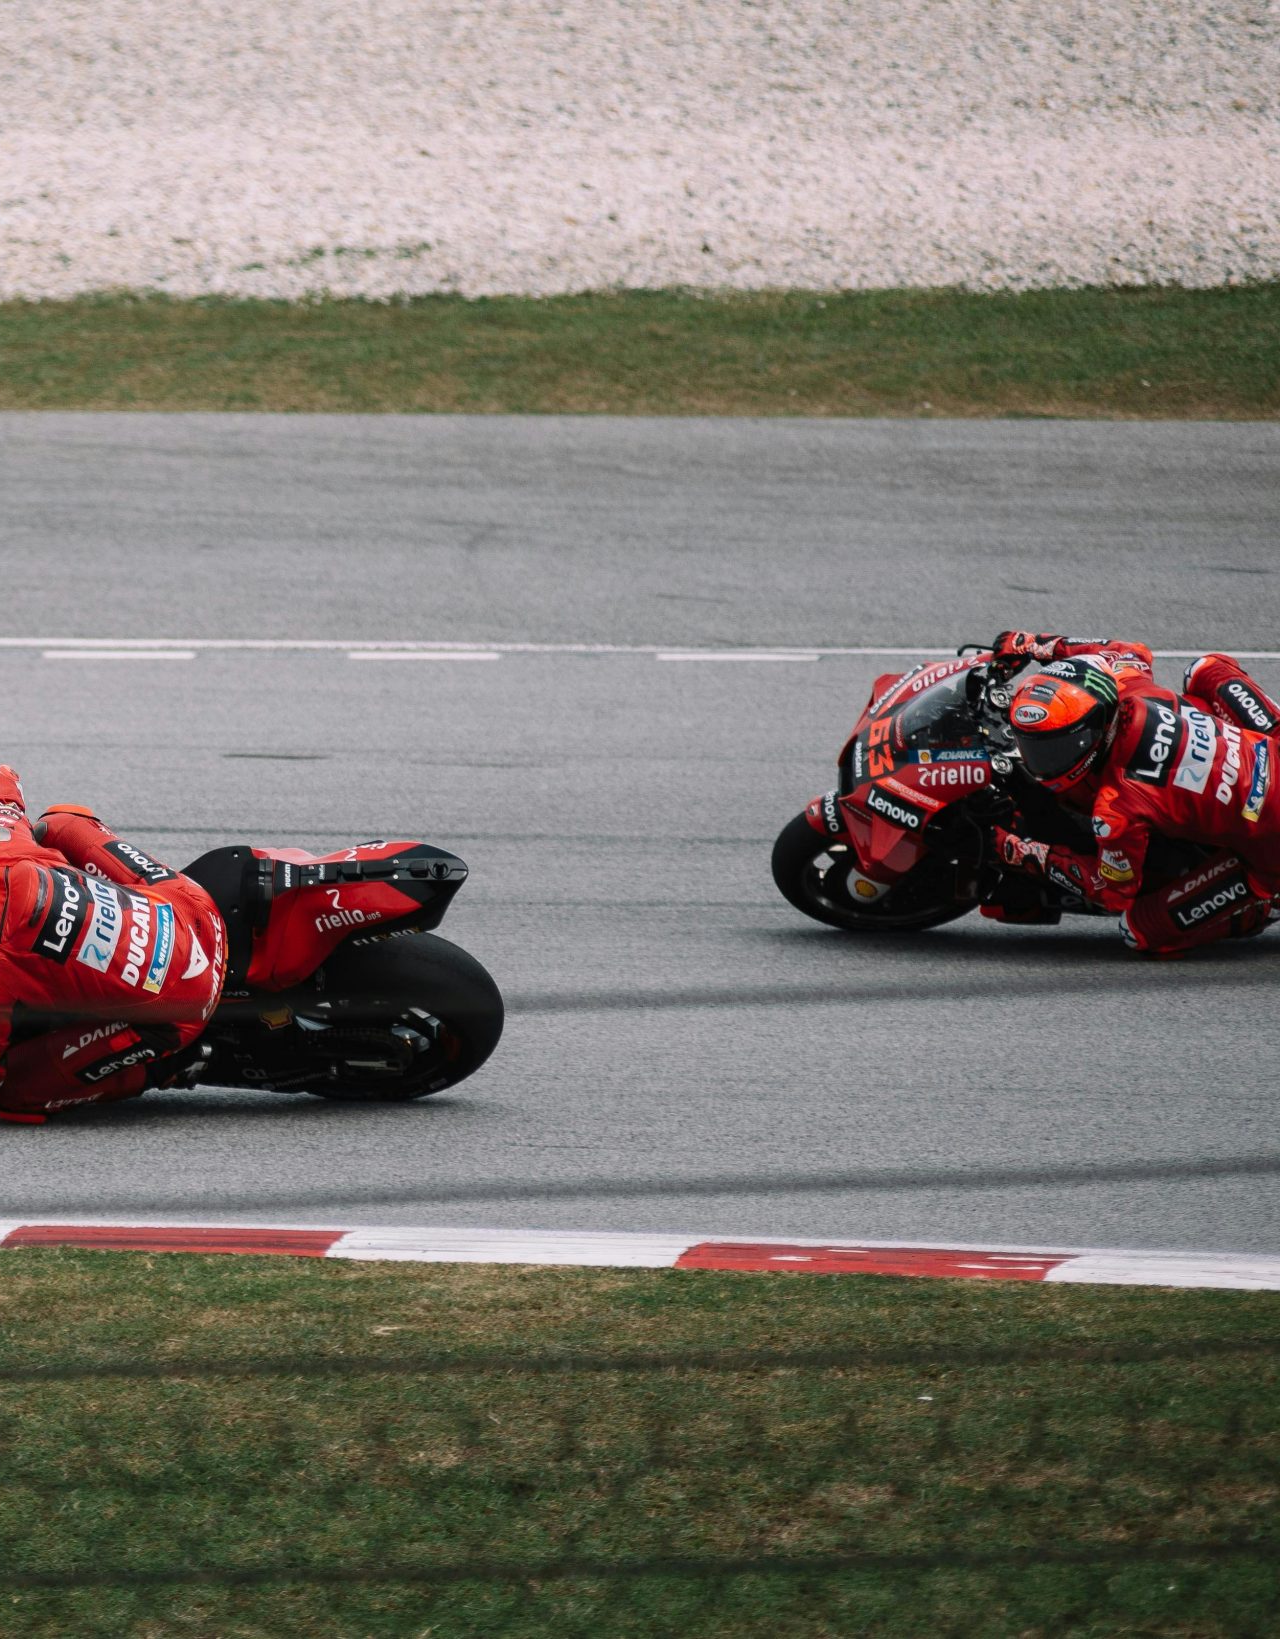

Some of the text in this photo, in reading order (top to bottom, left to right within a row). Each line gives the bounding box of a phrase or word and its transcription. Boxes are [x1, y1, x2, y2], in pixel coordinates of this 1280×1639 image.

[868, 717, 895, 777] 63
[937, 751, 984, 760] ADVANCE
[1216, 723, 1241, 806] DUCATI
[930, 766, 986, 786] riello
[825, 791, 839, 832] enovo
[867, 790, 919, 828] Lenovo
[314, 909, 365, 932] riello
[1178, 882, 1247, 926] Lenovo
[121, 894, 150, 987] DUCATI
[159, 908, 170, 966] MICHELIN
